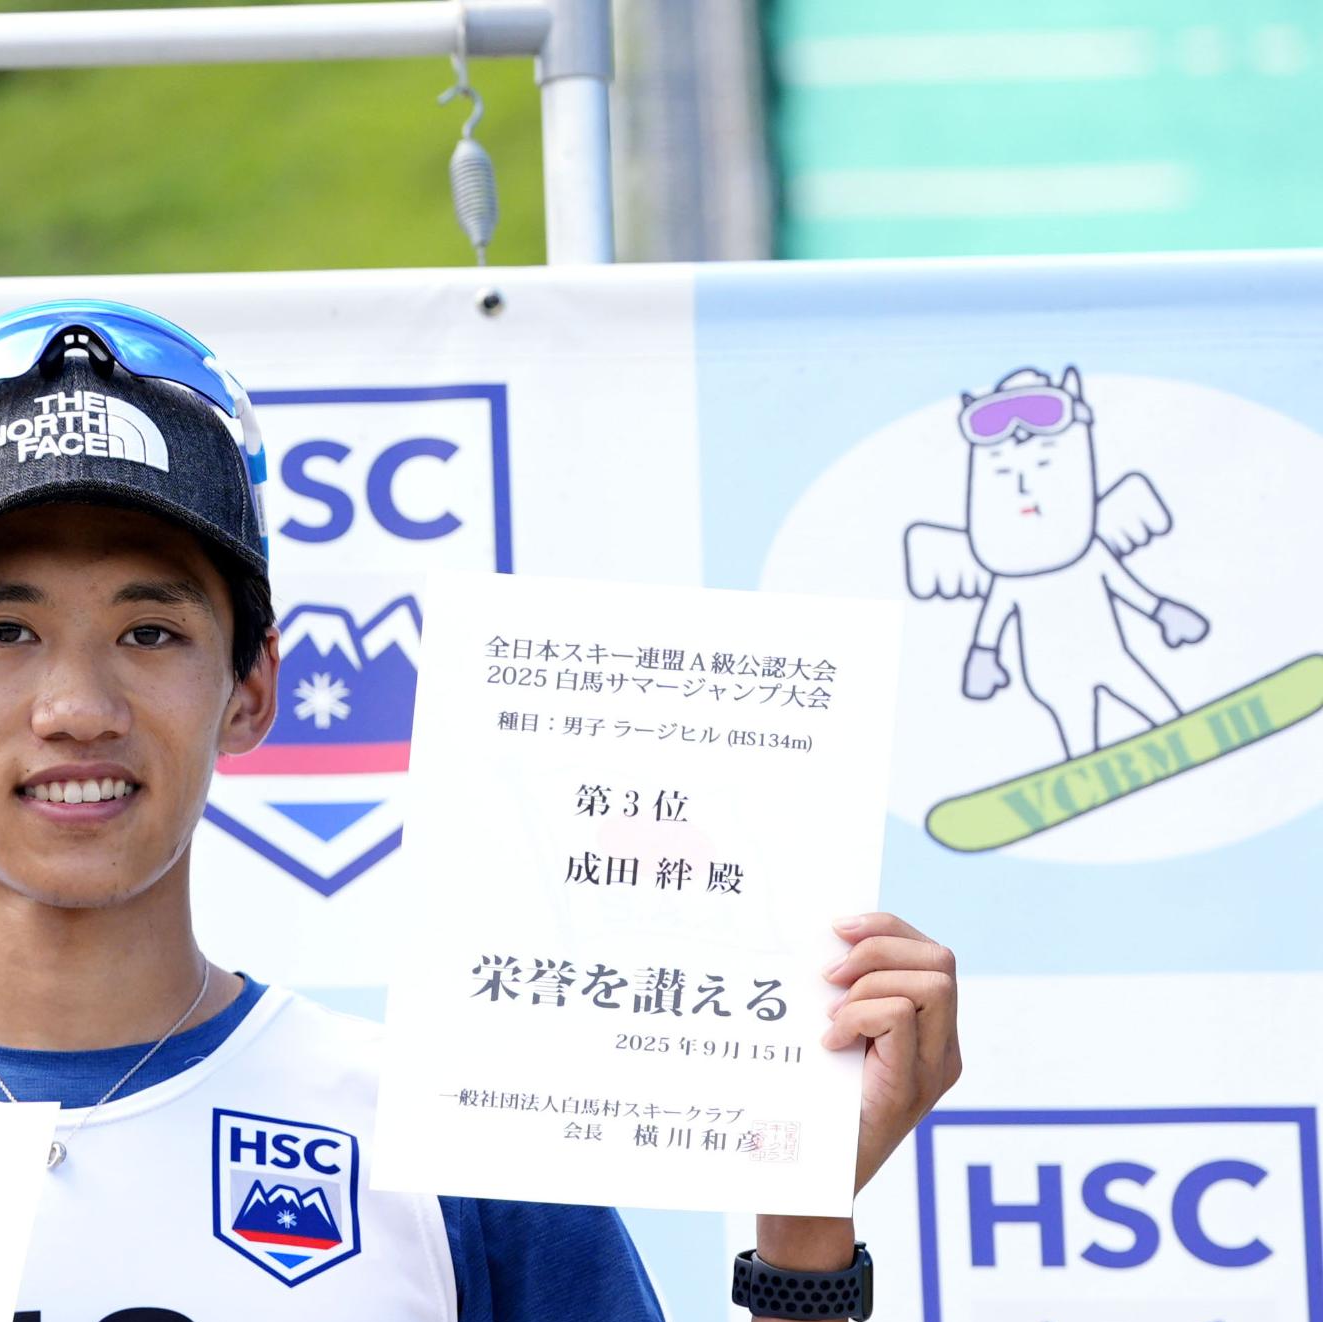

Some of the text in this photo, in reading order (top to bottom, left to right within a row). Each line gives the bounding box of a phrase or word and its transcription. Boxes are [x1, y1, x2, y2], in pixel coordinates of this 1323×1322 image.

[34, 390, 107, 415] THE
[17, 432, 108, 463] FACE
[240, 437, 463, 543] SC
[230, 1127, 342, 1176] HSC
[966, 1159, 1273, 1270] HSC
